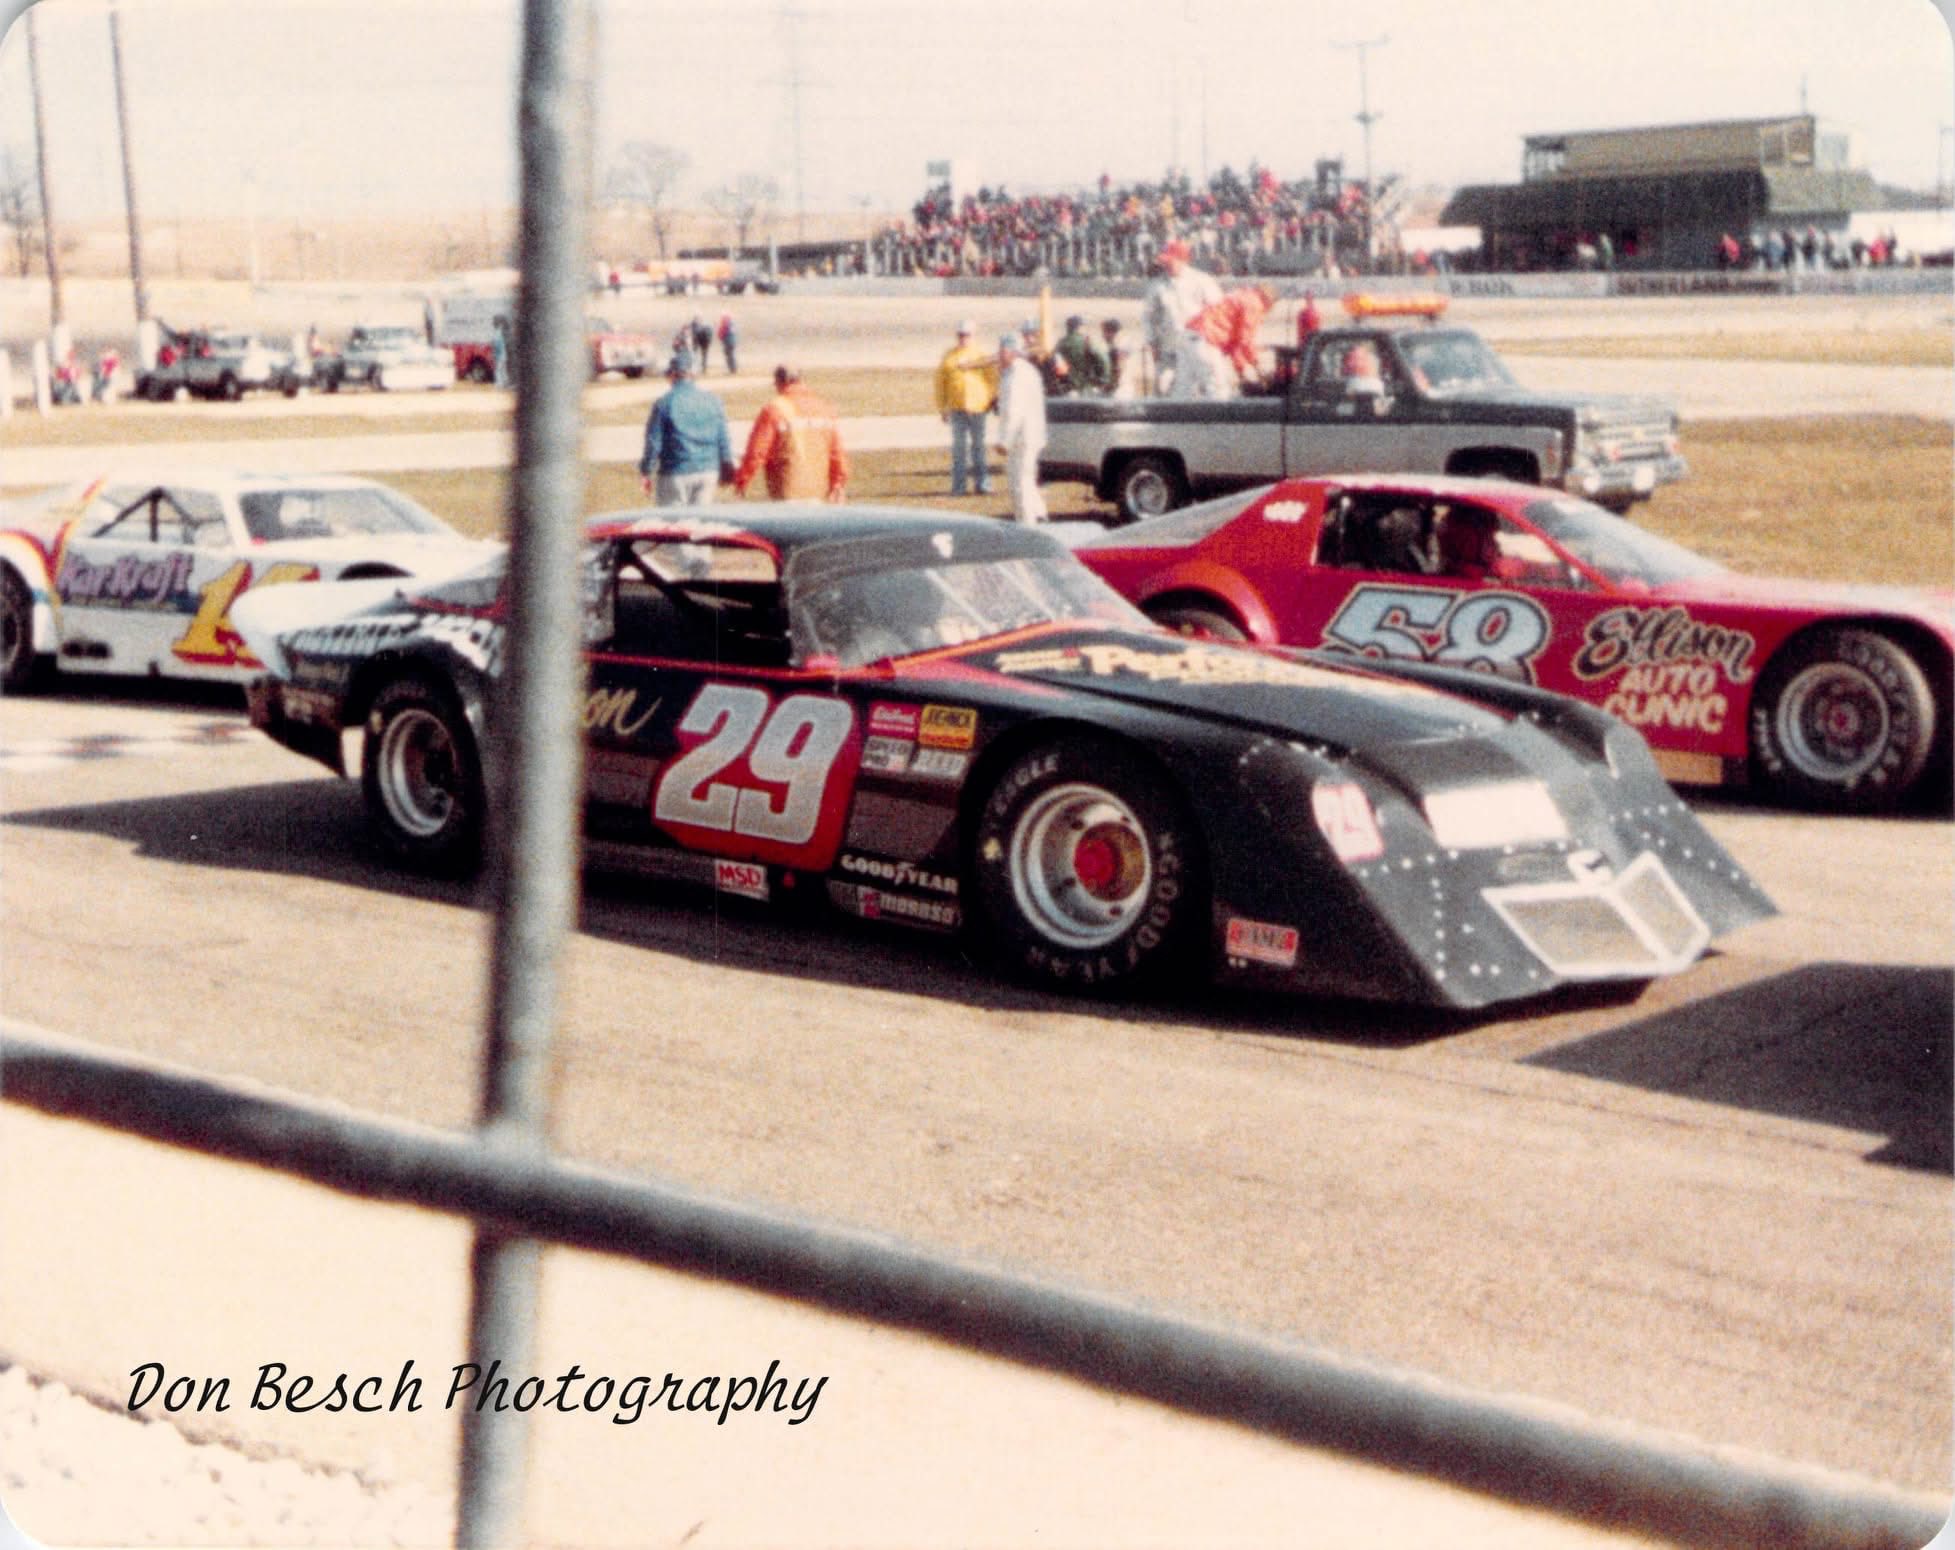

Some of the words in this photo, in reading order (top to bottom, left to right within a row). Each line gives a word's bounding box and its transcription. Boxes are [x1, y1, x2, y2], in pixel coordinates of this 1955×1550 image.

[1572, 606, 1755, 684] Ellison
[1620, 664, 1717, 698] AUTO
[1603, 692, 1728, 734] CLINIC
[653, 682, 854, 845] 29
[718, 864, 763, 888] MSD
